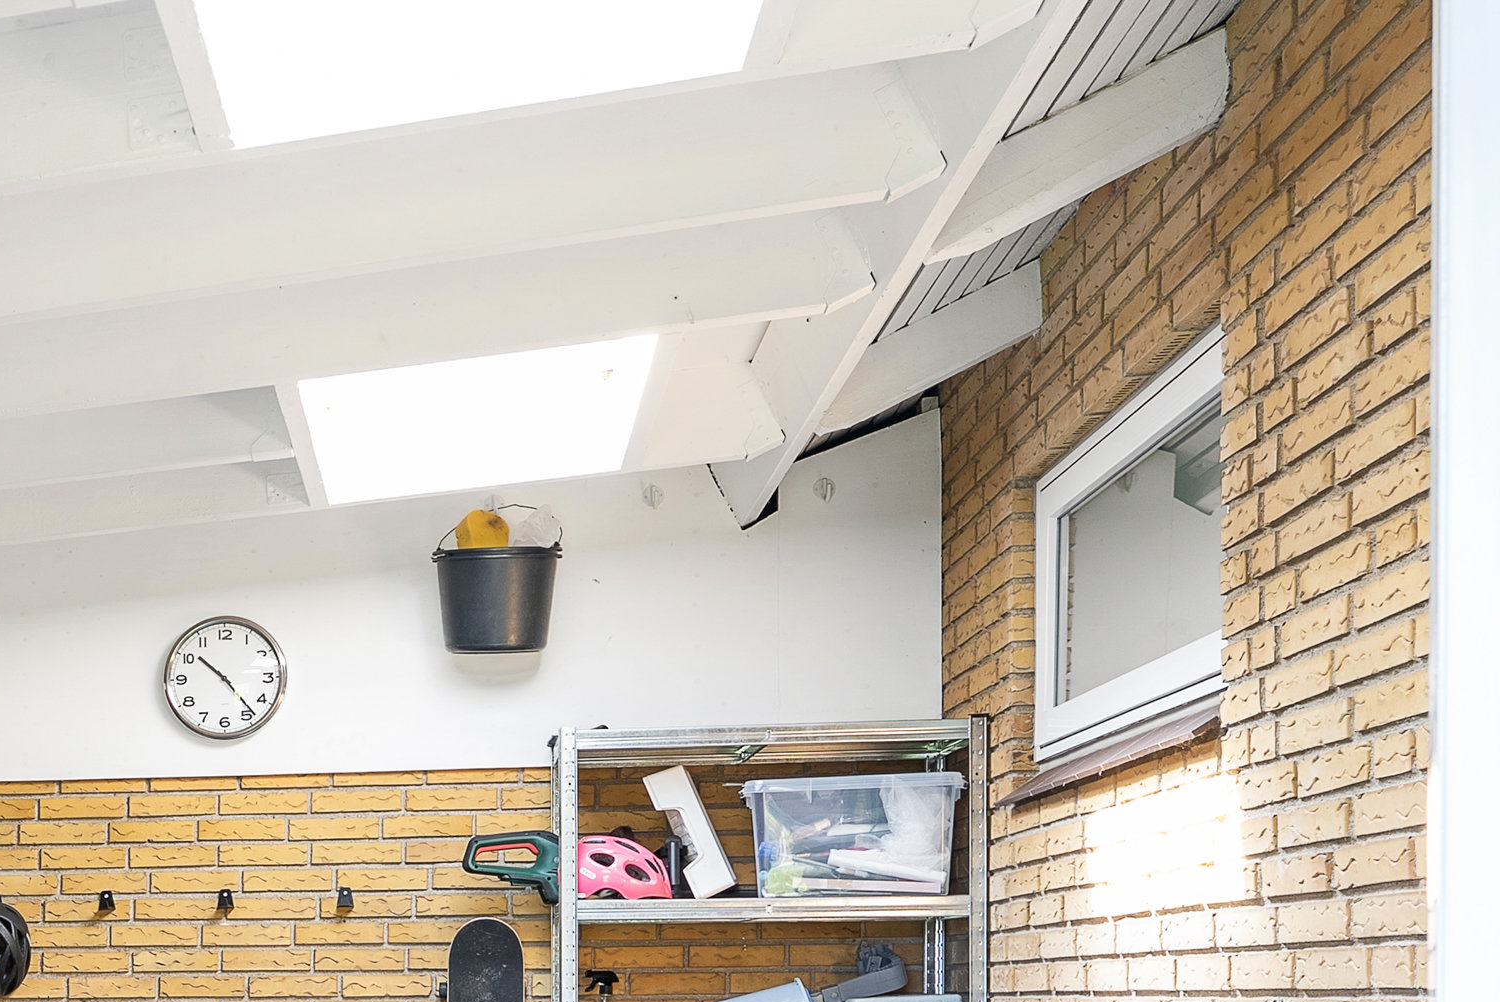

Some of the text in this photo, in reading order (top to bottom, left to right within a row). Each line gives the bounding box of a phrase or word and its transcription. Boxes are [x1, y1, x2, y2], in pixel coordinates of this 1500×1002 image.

[218, 629, 233, 641] 12
[199, 636, 207, 648] 11
[183, 653, 195, 664] 10
[175, 674, 188, 685] 9
[262, 672, 274, 684] 3
[182, 696, 195, 707] 8
[256, 693, 267, 704] 4
[198, 712, 209, 723] 7
[240, 710, 253, 721] 5
[219, 717, 231, 728] 6
